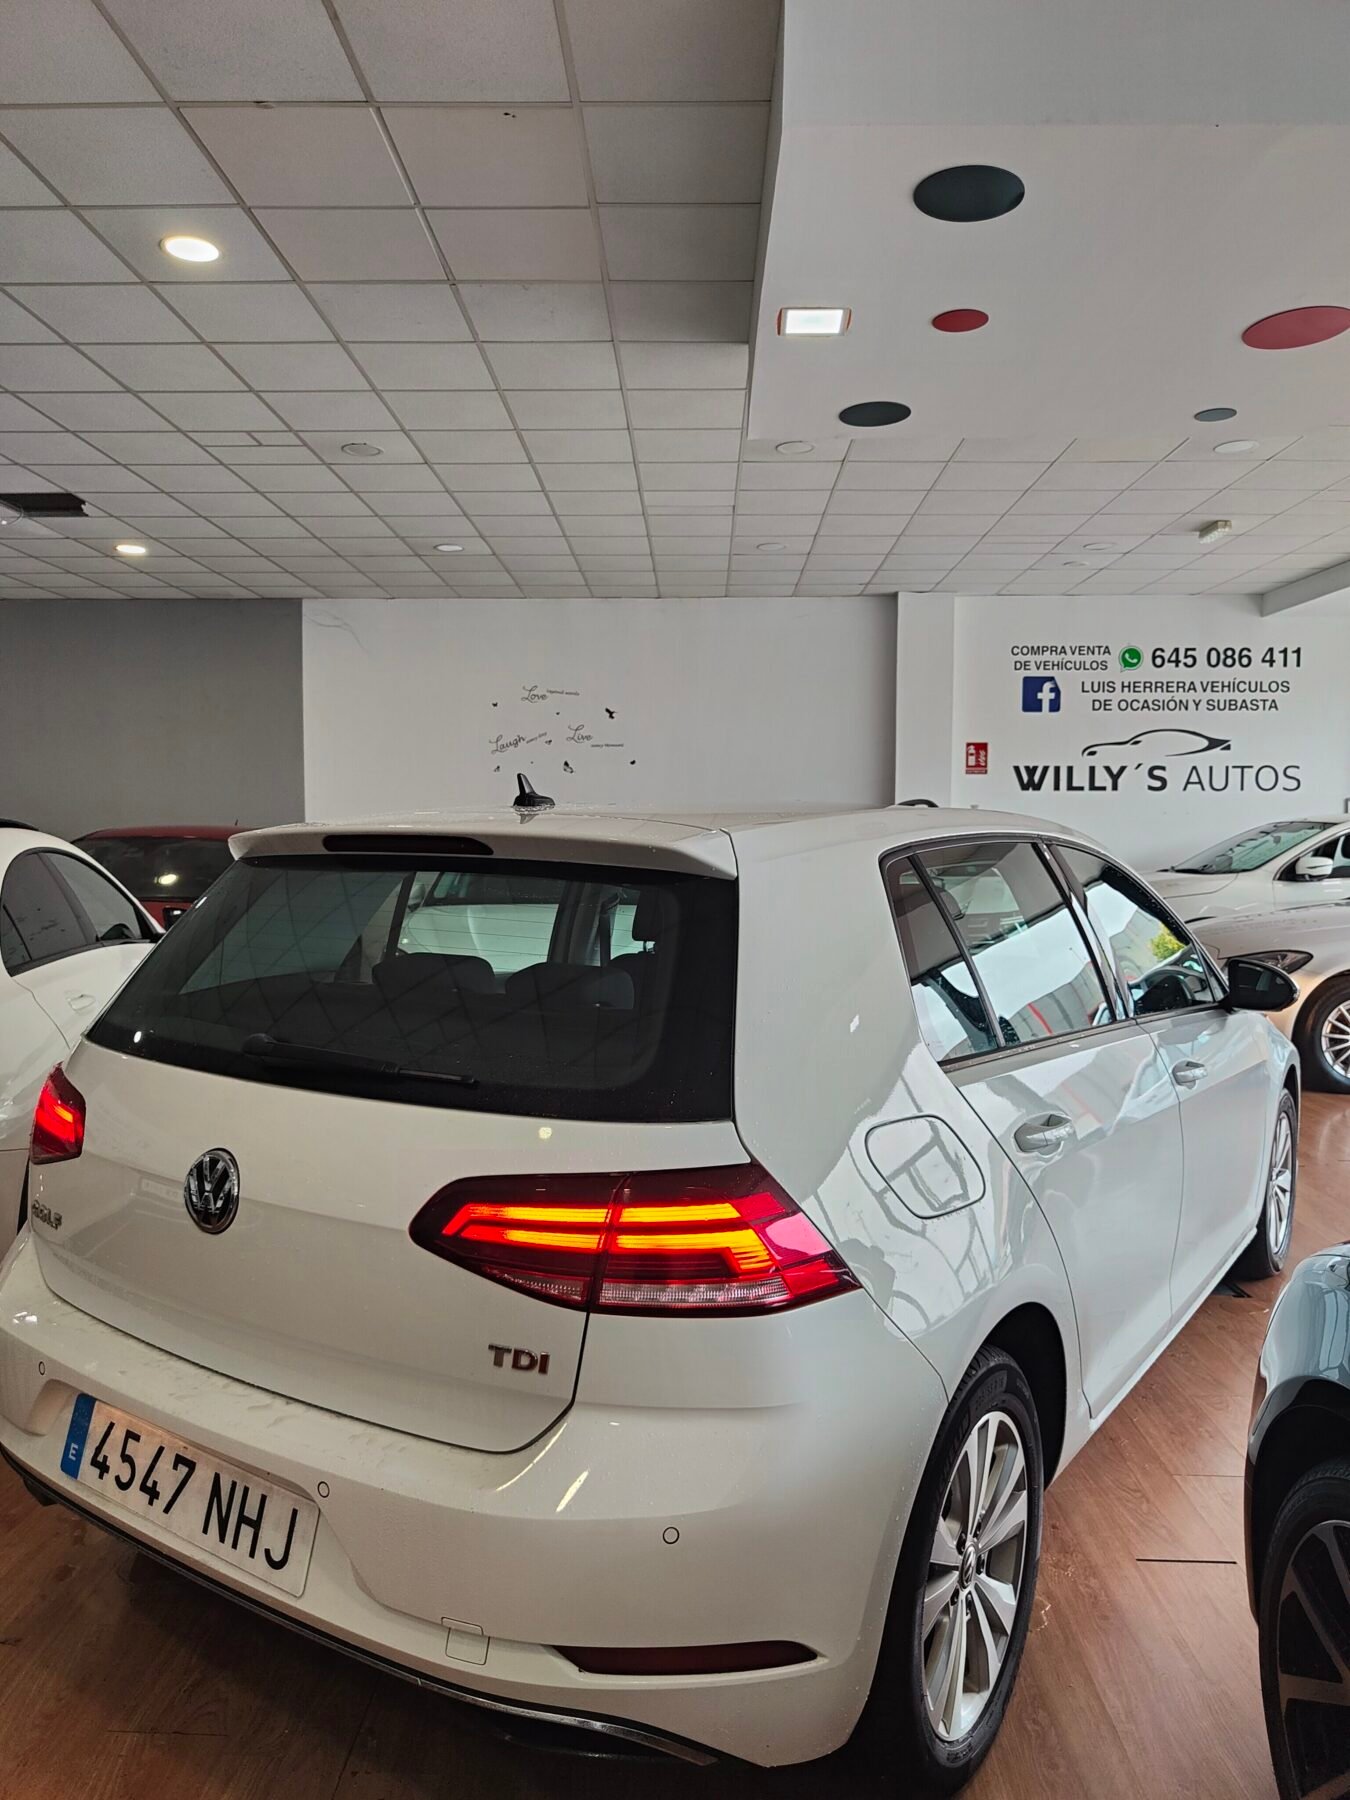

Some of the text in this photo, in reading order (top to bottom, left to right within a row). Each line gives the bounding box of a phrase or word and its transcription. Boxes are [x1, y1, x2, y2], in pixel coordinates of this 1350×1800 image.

[1011, 645, 1112, 656] COMPRA VENTA
[1151, 647, 1302, 668] 645 086 411
[1014, 658, 1108, 671] DE VEHÍCULOS
[521, 685, 548, 703] Love
[1081, 677, 1290, 693] LUIS HERRERA VEHÍCULOS
[1092, 696, 1279, 711] DE OCASIÓN Y SUBASTA
[566, 724, 593, 743] Live
[489, 734, 526, 754] Laugh
[1183, 765, 1301, 791] AUTOS
[488, 1343, 550, 1375] TDI
[68, 1443, 79, 1461] E
[90, 1422, 298, 1570] 4547 NHJ
